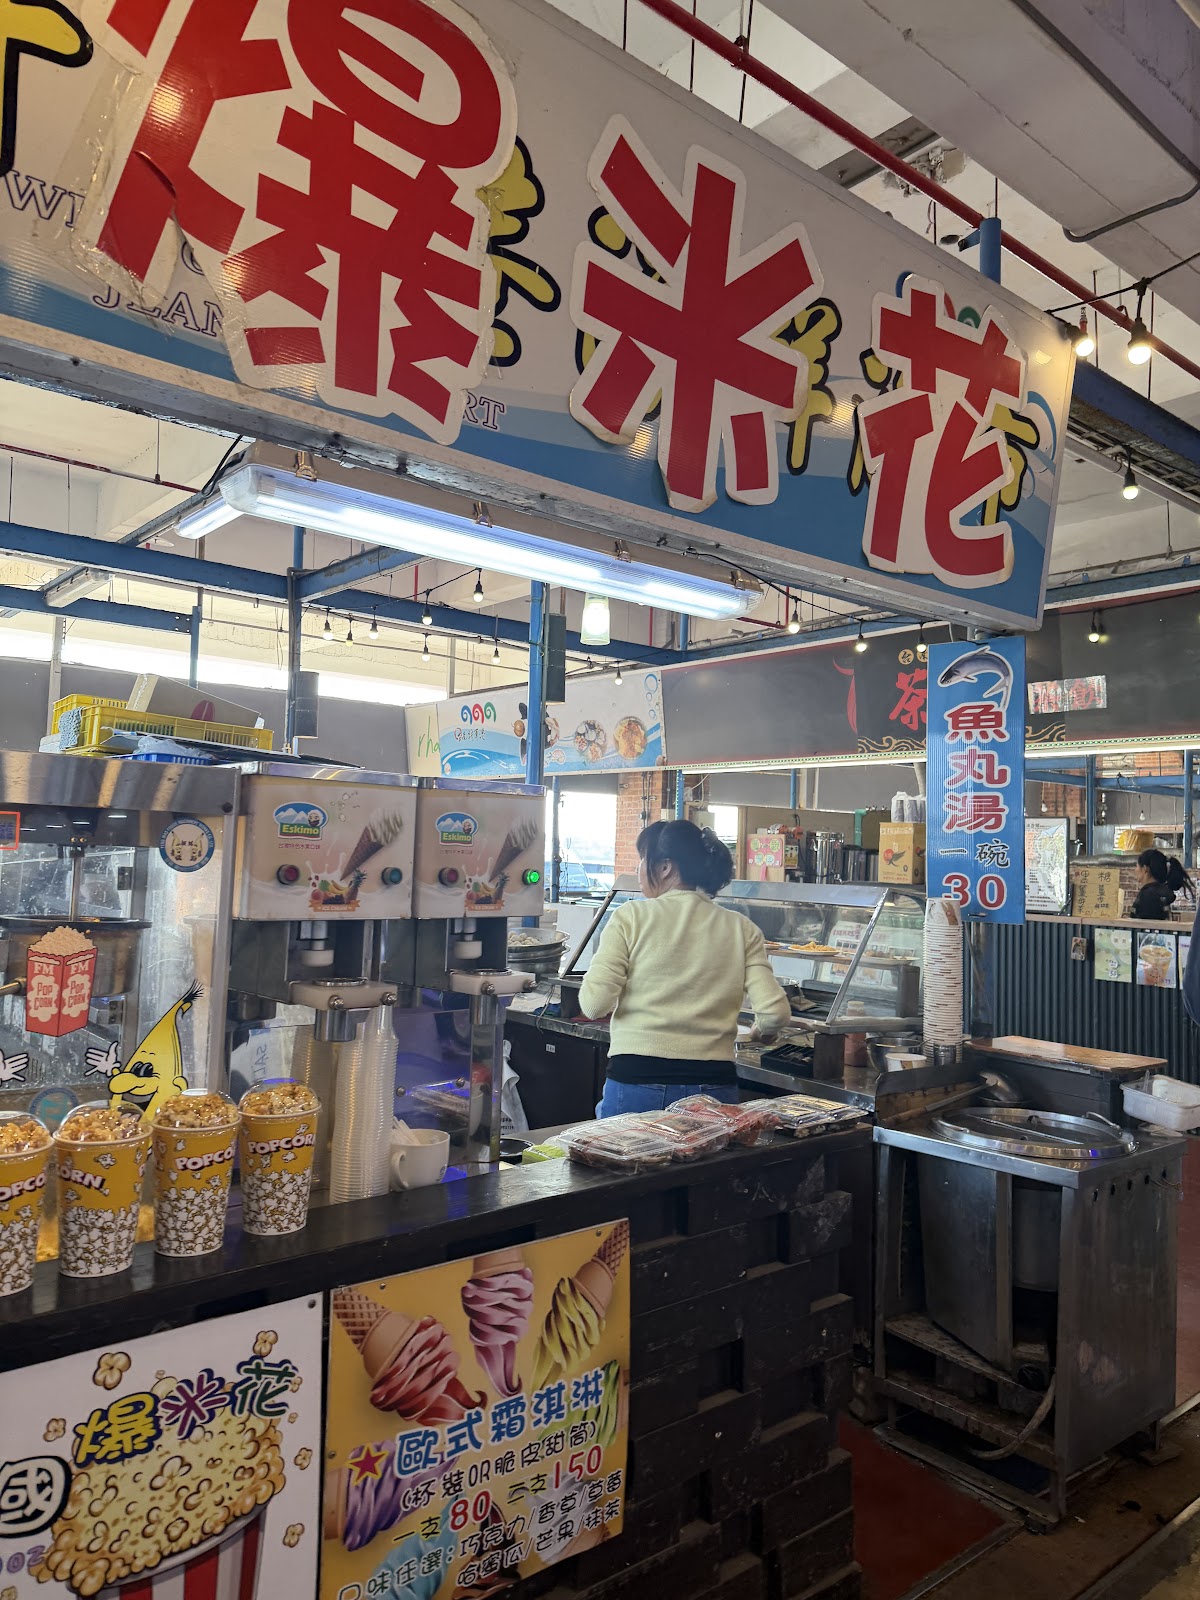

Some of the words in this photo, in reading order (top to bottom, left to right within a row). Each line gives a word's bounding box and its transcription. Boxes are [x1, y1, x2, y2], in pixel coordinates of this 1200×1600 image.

[97, 0, 1024, 580] 爆米花
[945, 703, 1009, 832] 魚丸湯
[282, 824, 319, 834] Eskimo
[442, 832, 471, 842] Eskimo
[939, 839, 1010, 868] 一碗
[942, 872, 1008, 910] 30
[33, 961, 54, 975] FM
[70, 960, 89, 974] FM
[247, 1133, 315, 1154] POPCOR
[73, 1356, 297, 1468] 爆米花
[395, 1370, 604, 1476] 歐式霜淇淋
[393, 1516, 441, 1543] 一支
[449, 1491, 491, 1531] 80
[506, 1473, 548, 1505] 二支
[554, 1445, 602, 1489] 150
